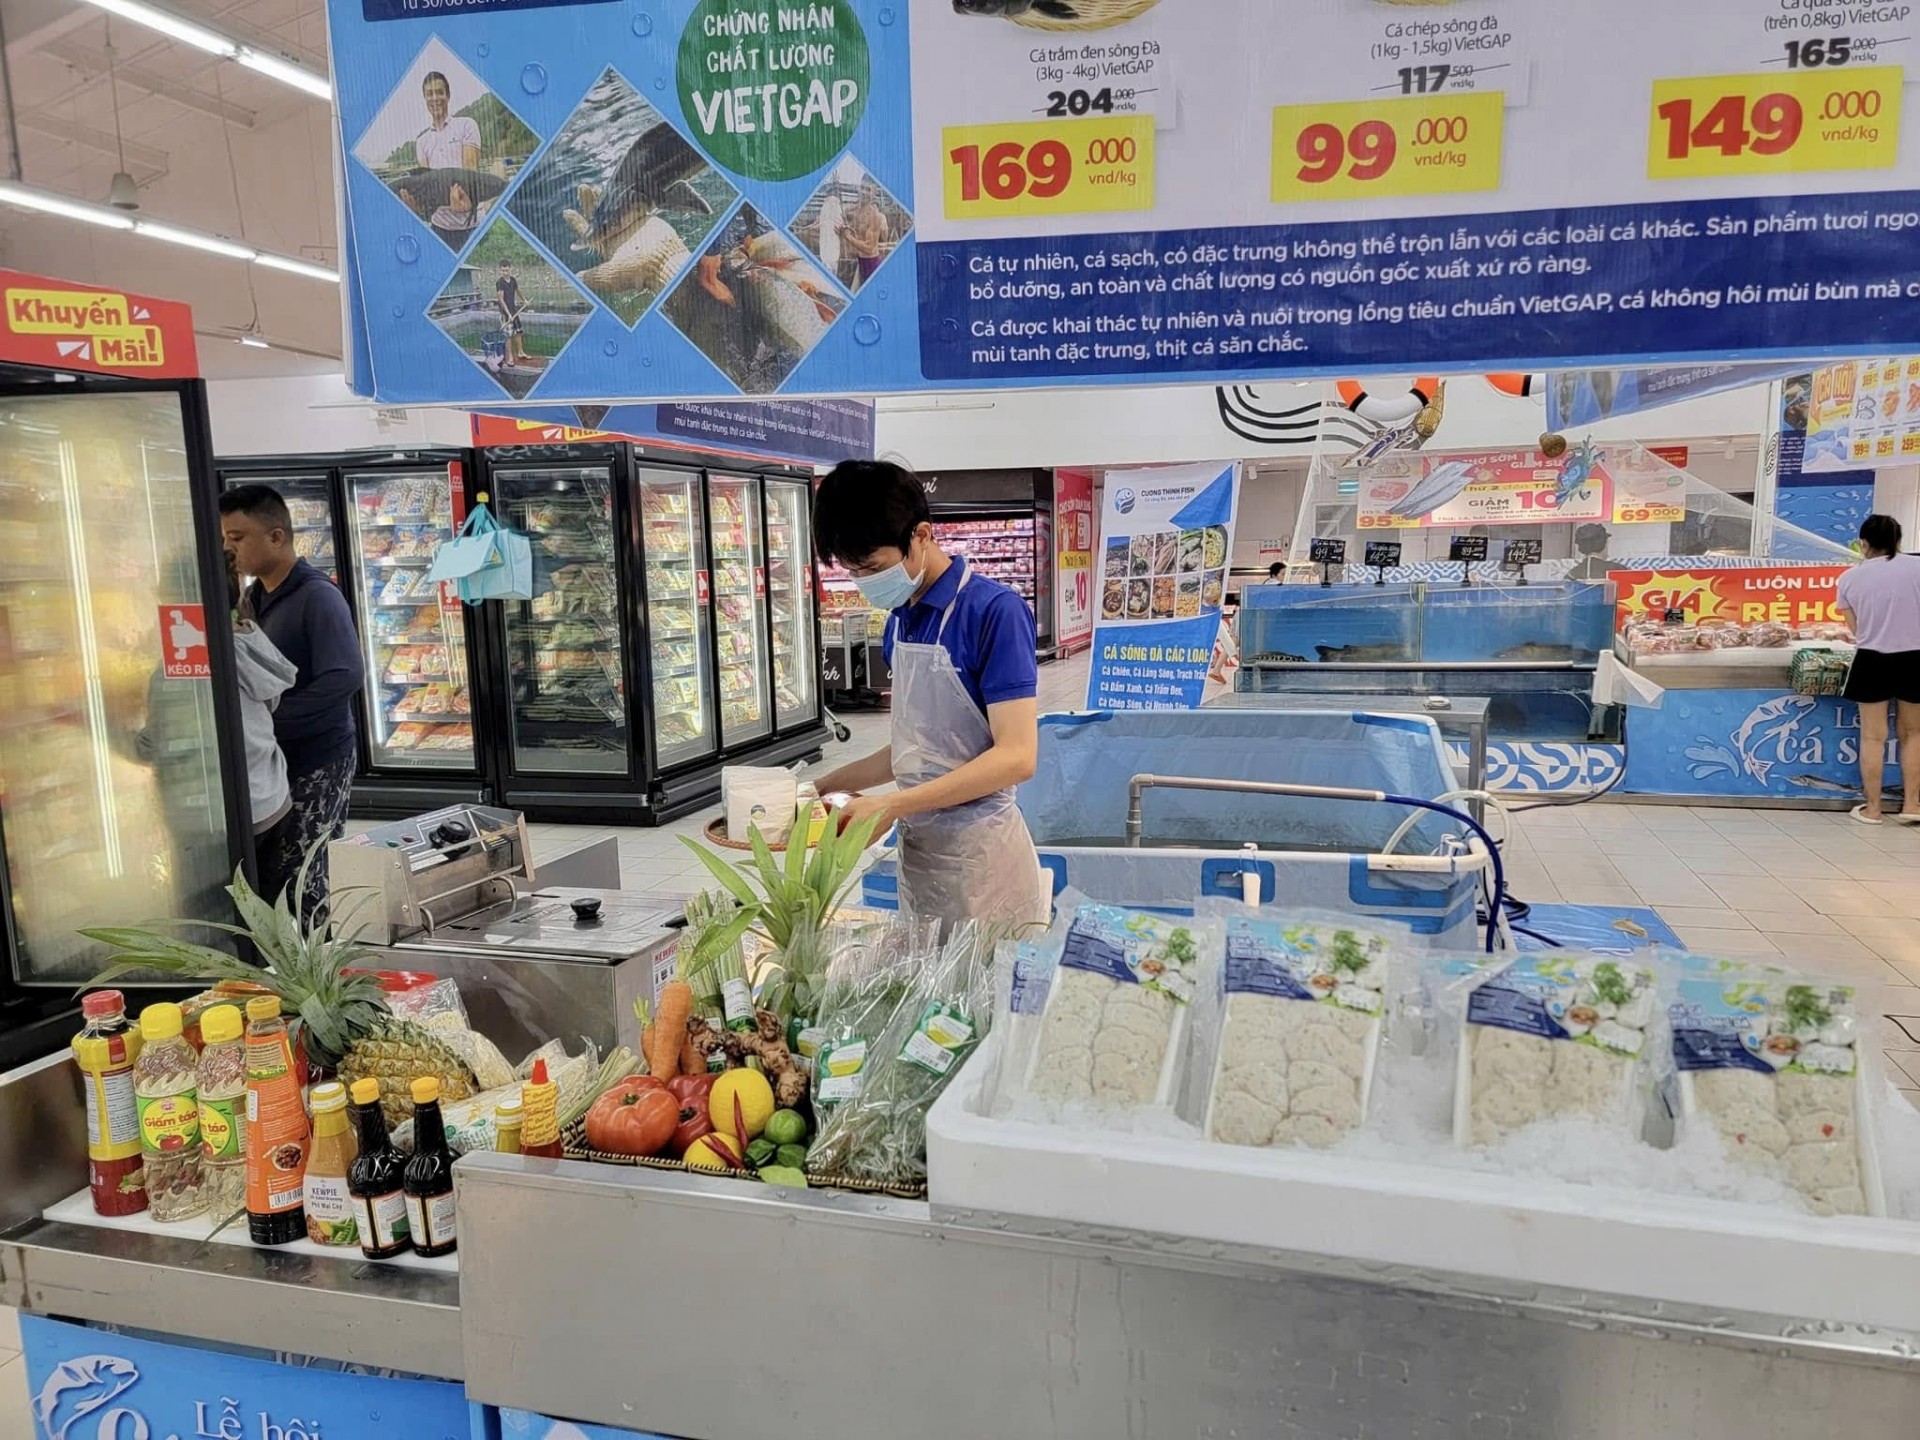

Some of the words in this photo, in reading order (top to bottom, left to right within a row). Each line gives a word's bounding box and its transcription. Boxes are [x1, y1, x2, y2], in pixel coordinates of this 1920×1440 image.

[703, 8, 770, 37] CHỨNG
[778, 2, 835, 35] NHẬN
[1385, 22, 1403, 38] Cá
[1405, 20, 1440, 39] chép
[1442, 18, 1477, 35] sông
[1480, 15, 1498, 31] đà
[1764, 14, 1798, 32] (trên
[1800, 11, 1846, 31] 0,8kg)
[1849, 6, 1910, 24] VietGAP
[706, 39, 760, 74] CHẤT
[769, 43, 835, 74] LƯỢNG
[1029, 46, 1046, 63] Cá
[1048, 44, 1078, 62] trắm
[1080, 44, 1105, 60] đen
[1108, 43, 1139, 60] sông
[1142, 41, 1160, 56] Đà
[1371, 43, 1400, 60] (1kg
[1412, 39, 1452, 59] 1,5kg)
[1454, 33, 1512, 51] VietGAP
[1784, 37, 1851, 69] 165
[1036, 66, 1064, 83] (3kg
[1072, 63, 1100, 81] 4kg)
[1101, 59, 1154, 76] VietGAP
[1398, 64, 1451, 94] 117
[691, 79, 858, 136] VIETGAP
[1047, 88, 1113, 117] 204
[1658, 92, 1803, 160] 149
[1818, 90, 1882, 121] .000
[1822, 126, 1879, 143] vnd/kg
[1296, 120, 1397, 183] 99
[1411, 116, 1468, 146] .000
[1414, 150, 1467, 167] vnd/kg
[950, 140, 1072, 201] 169
[1085, 137, 1136, 165] .000
[1088, 170, 1137, 186] vnd/kg
[969, 255, 994, 273] Cá
[998, 256, 1018, 276] tự
[1023, 253, 1080, 272] nhiên,
[1084, 251, 1106, 268] cá
[1111, 249, 1160, 268] sạch,
[1163, 247, 1187, 265] có
[1192, 245, 1228, 264] đặc
[1233, 243, 1288, 262] trưng
[1293, 239, 1357, 260] không
[1361, 232, 1396, 255] thể
[1400, 235, 1444, 257] trộn
[1450, 227, 1480, 250] lẫn
[1485, 229, 1517, 248] với
[1522, 228, 1560, 246] các
[1566, 223, 1604, 243] loài
[1609, 221, 1636, 241] cá
[1641, 218, 1700, 240] khác.
[1706, 214, 1748, 236] Sản
[1753, 210, 1817, 237] phẩm
[1823, 211, 1869, 231] tươi
[970, 280, 995, 300] bổ
[999, 280, 1065, 299] dưỡng,
[1070, 281, 1093, 296] an
[1099, 278, 1141, 294] toàn
[1144, 277, 1167, 293] và
[1171, 269, 1214, 291] chất
[1219, 271, 1276, 292] lượng
[1280, 268, 1305, 287] có
[1311, 263, 1375, 288] nguồn
[1380, 260, 1420, 285] gốc
[1425, 256, 1471, 279] xuất
[1476, 258, 1504, 277] xứ
[1509, 256, 1532, 275] rõ
[1537, 254, 1592, 275] ràng.
[13, 298, 122, 329] Khuyến
[971, 319, 995, 337] Cá
[999, 319, 1048, 338] được
[1053, 316, 1091, 334] khai
[1096, 314, 1137, 332] thác
[1141, 314, 1162, 334] tự
[1166, 311, 1219, 330] nhiên
[1223, 309, 1245, 327] và
[1251, 305, 1293, 326] nuôi
[1297, 308, 1352, 326] trong
[1358, 300, 1403, 323] lồng
[1408, 300, 1447, 320] tiêu
[1451, 294, 1516, 318] chuẩn
[1519, 293, 1613, 315] VietGAP,
[1619, 290, 1644, 310] cá
[1650, 287, 1721, 309] không
[1726, 283, 1761, 305] hôi
[1767, 282, 1809, 303] mùi
[1814, 280, 1859, 300] bùn
[1865, 278, 1901, 299] mà
[100, 328, 158, 362] Mãi!
[971, 345, 1006, 363] mùi
[1010, 344, 1050, 362] tanh
[1055, 342, 1090, 363] đặc
[1094, 342, 1151, 360] trưng,
[1155, 339, 1188, 359] thịt
[1192, 337, 1215, 355] cá
[1219, 336, 1252, 354] săn
[1256, 330, 1309, 352] chắc.
[1359, 515, 1392, 527] 95
[1621, 509, 1650, 521] 69
[1641, 587, 1706, 614] GIÁ
[1744, 575, 1802, 590] LUÔN
[1742, 593, 1791, 622] RẺ
[1103, 643, 1118, 660] CÁ
[1120, 643, 1147, 661] SÔNG
[1165, 644, 1185, 663] CÁC
[1776, 726, 1824, 765] cá
[178, 1110, 198, 1123] táo
[208, 1122, 227, 1132] táo
[312, 1188, 338, 1196] KEWPIE
[194, 1396, 242, 1440] Lễ
